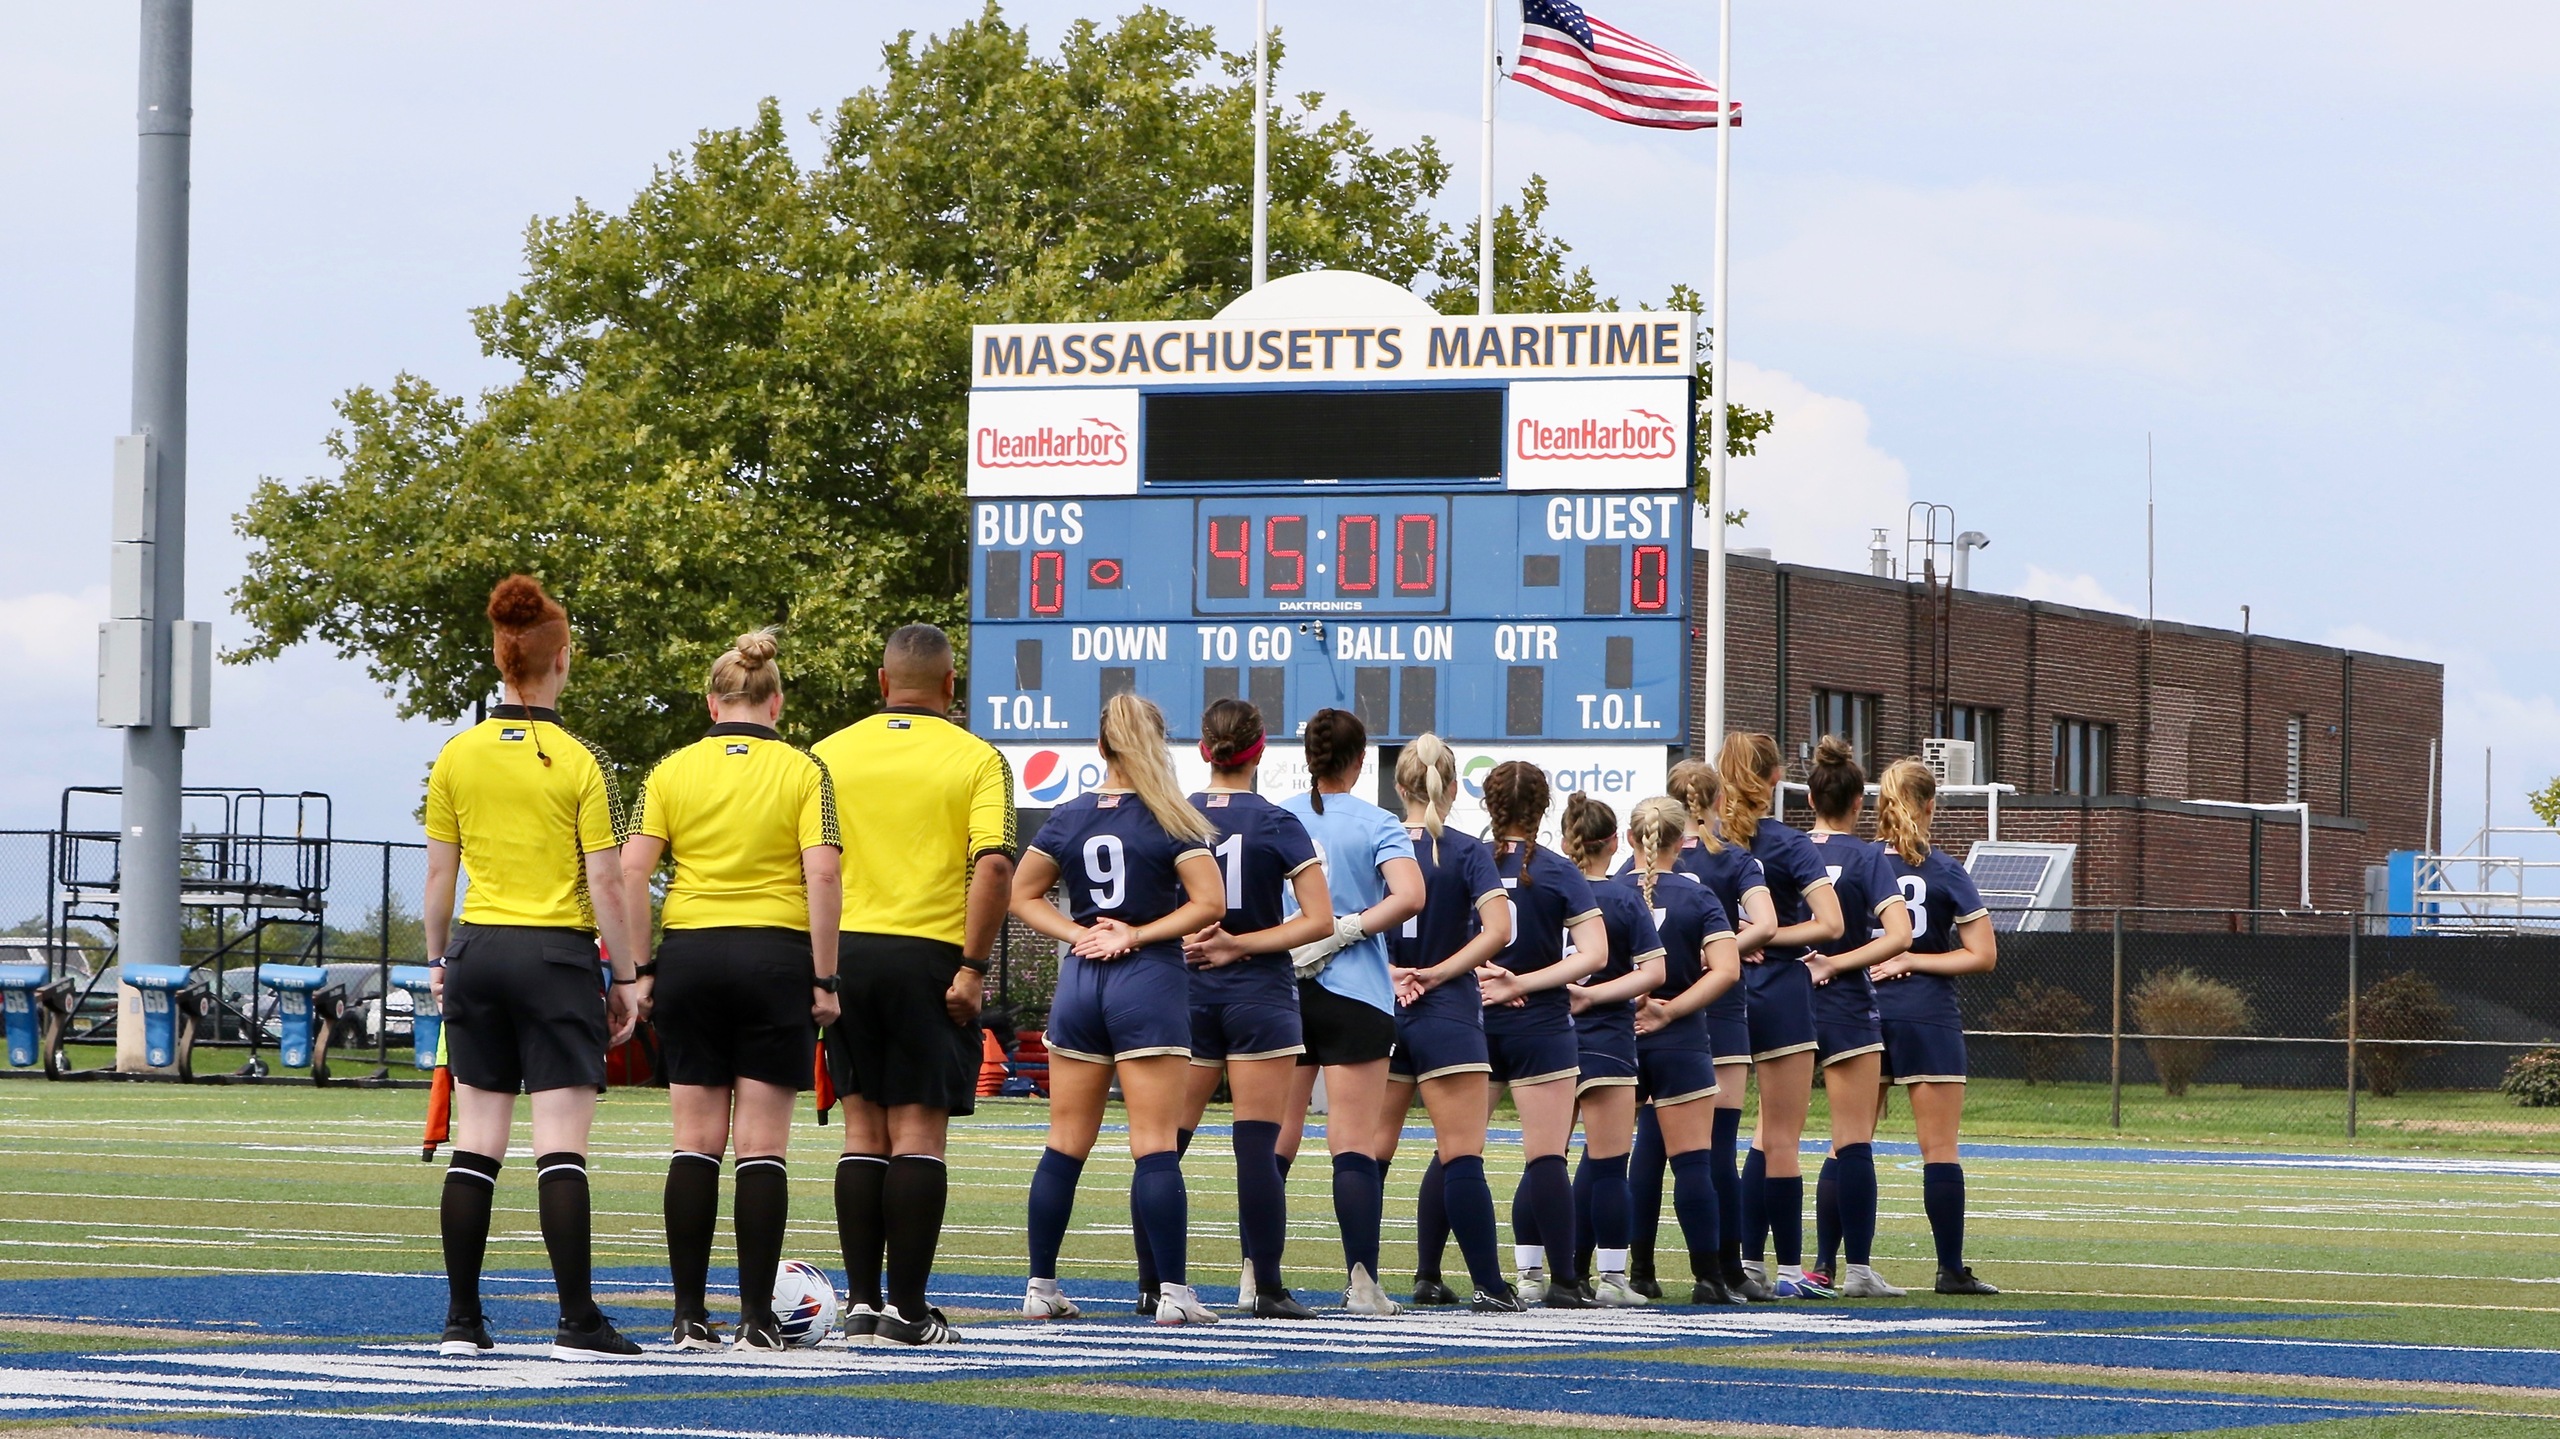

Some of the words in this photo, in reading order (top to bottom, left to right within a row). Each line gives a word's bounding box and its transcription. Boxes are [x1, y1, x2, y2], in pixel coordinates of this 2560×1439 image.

[982, 326, 1403, 377] MASSACHUSETTS
[1427, 322, 1680, 369] MARITIME
[977, 427, 1128, 468] CleanHarbors
[1517, 418, 1676, 460] CleanHarbors
[977, 502, 1084, 546] BUCS
[1546, 496, 1679, 541] GUEST
[1209, 513, 1436, 590] 45:00
[1031, 551, 1063, 613] 0
[1632, 546, 1667, 609] 0
[1279, 602, 1362, 611] DAKTRONICS
[1071, 626, 1167, 661] DOWN
[1197, 626, 1238, 661] TO
[1248, 626, 1292, 661] GO
[1337, 626, 1406, 660] BALL
[1413, 625, 1453, 661] ON
[1494, 625, 1558, 662] QTR
[988, 695, 1069, 730] T.O.L.
[1576, 694, 1661, 729] T.O.L.
[1083, 835, 1125, 909] 9
[1871, 875, 1927, 938] 3
